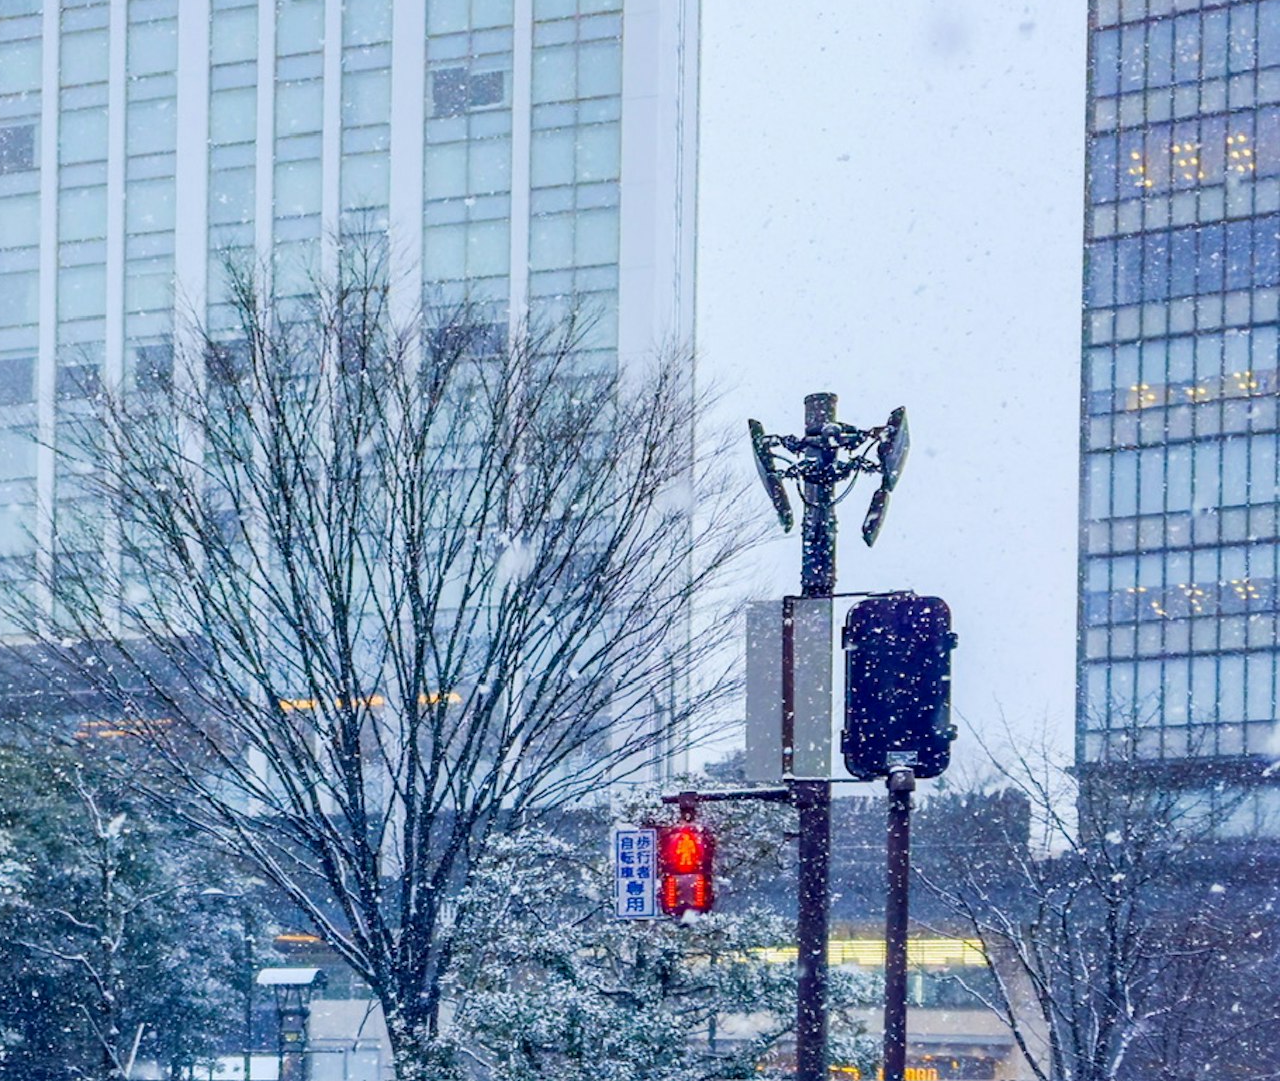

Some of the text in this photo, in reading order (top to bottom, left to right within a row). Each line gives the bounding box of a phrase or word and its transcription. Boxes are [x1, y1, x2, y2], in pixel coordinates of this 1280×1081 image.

[621, 836, 634, 878] 自転車
[637, 836, 651, 878] 歩行者
[626, 881, 645, 912] 専用
